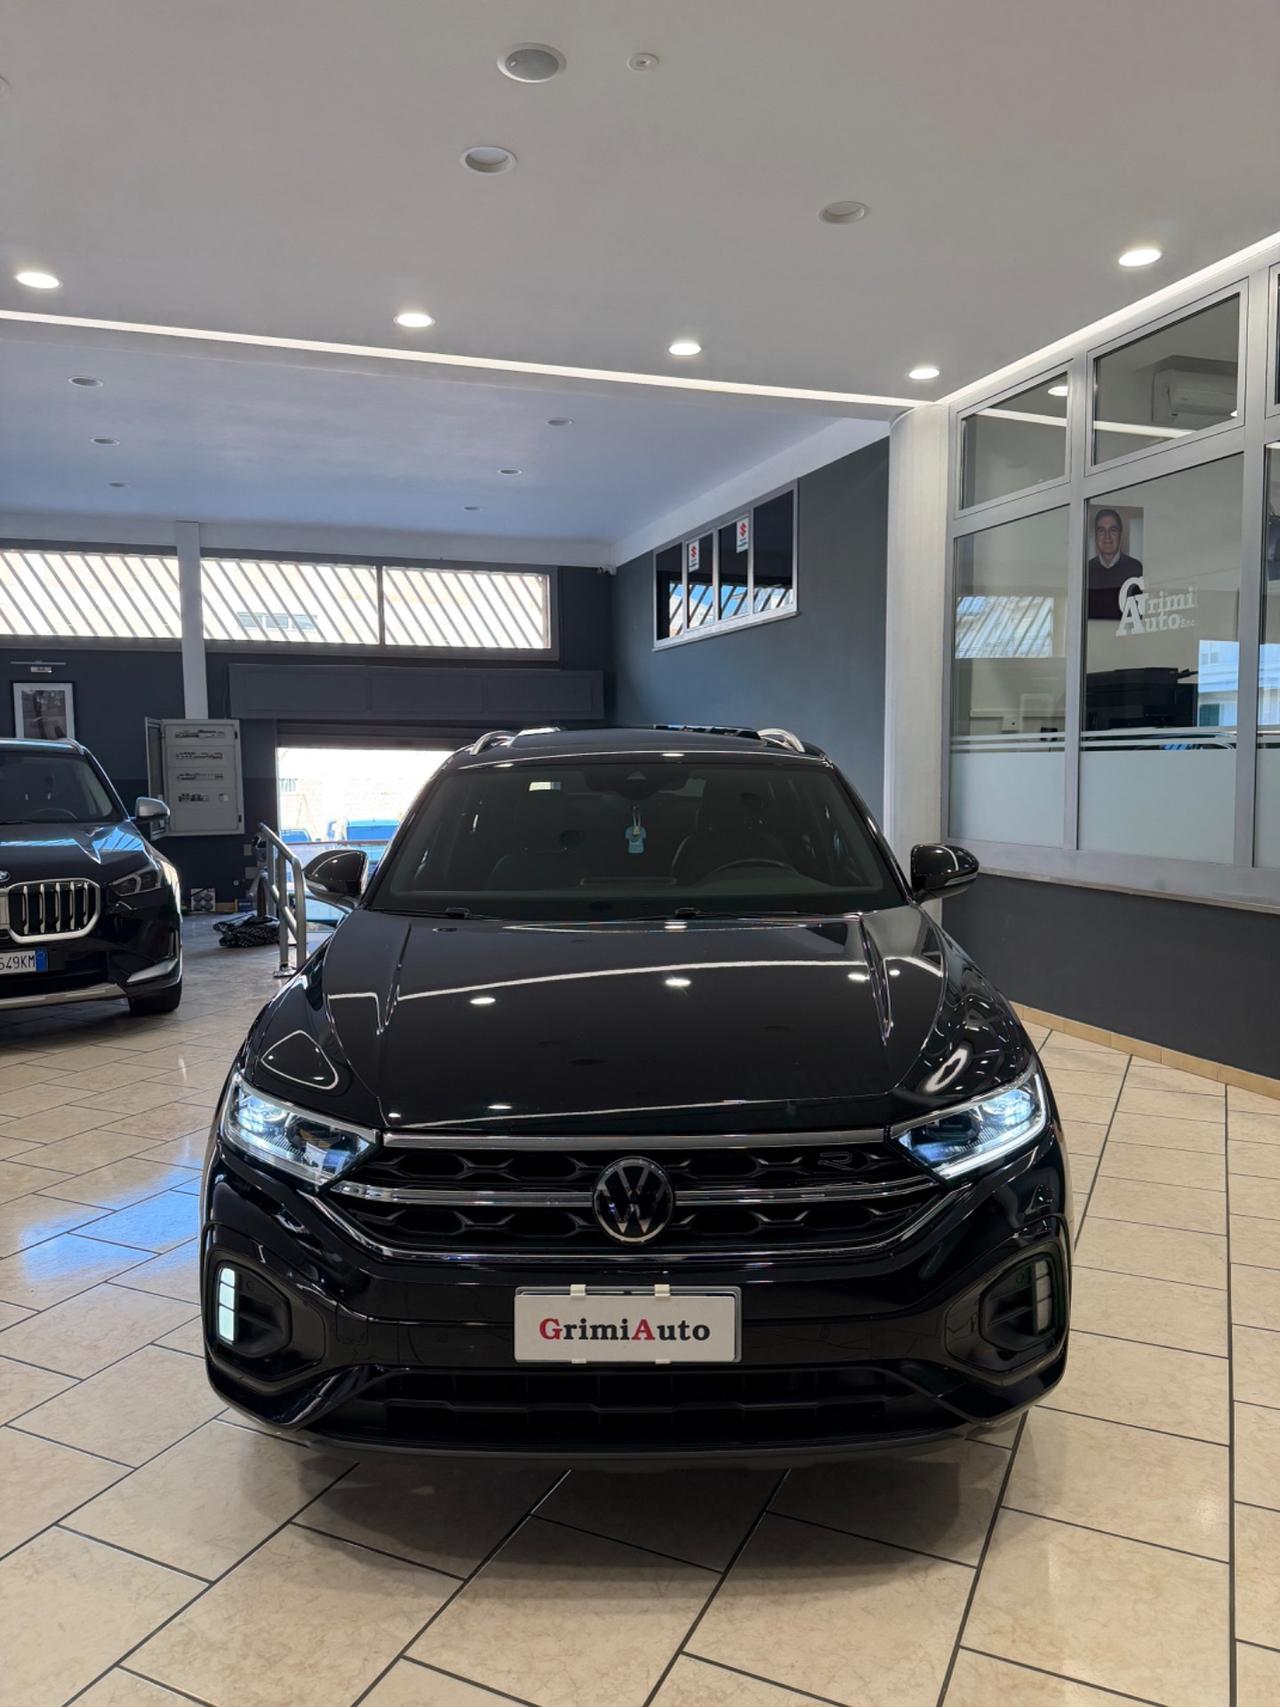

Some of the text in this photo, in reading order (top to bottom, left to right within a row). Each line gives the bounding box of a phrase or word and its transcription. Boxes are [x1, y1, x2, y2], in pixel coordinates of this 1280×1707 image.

[1118, 576, 1195, 616] Grimi
[1116, 596, 1180, 637] Auto
[817, 1151, 857, 1171] R
[539, 1318, 710, 1341] GrimiAuto
